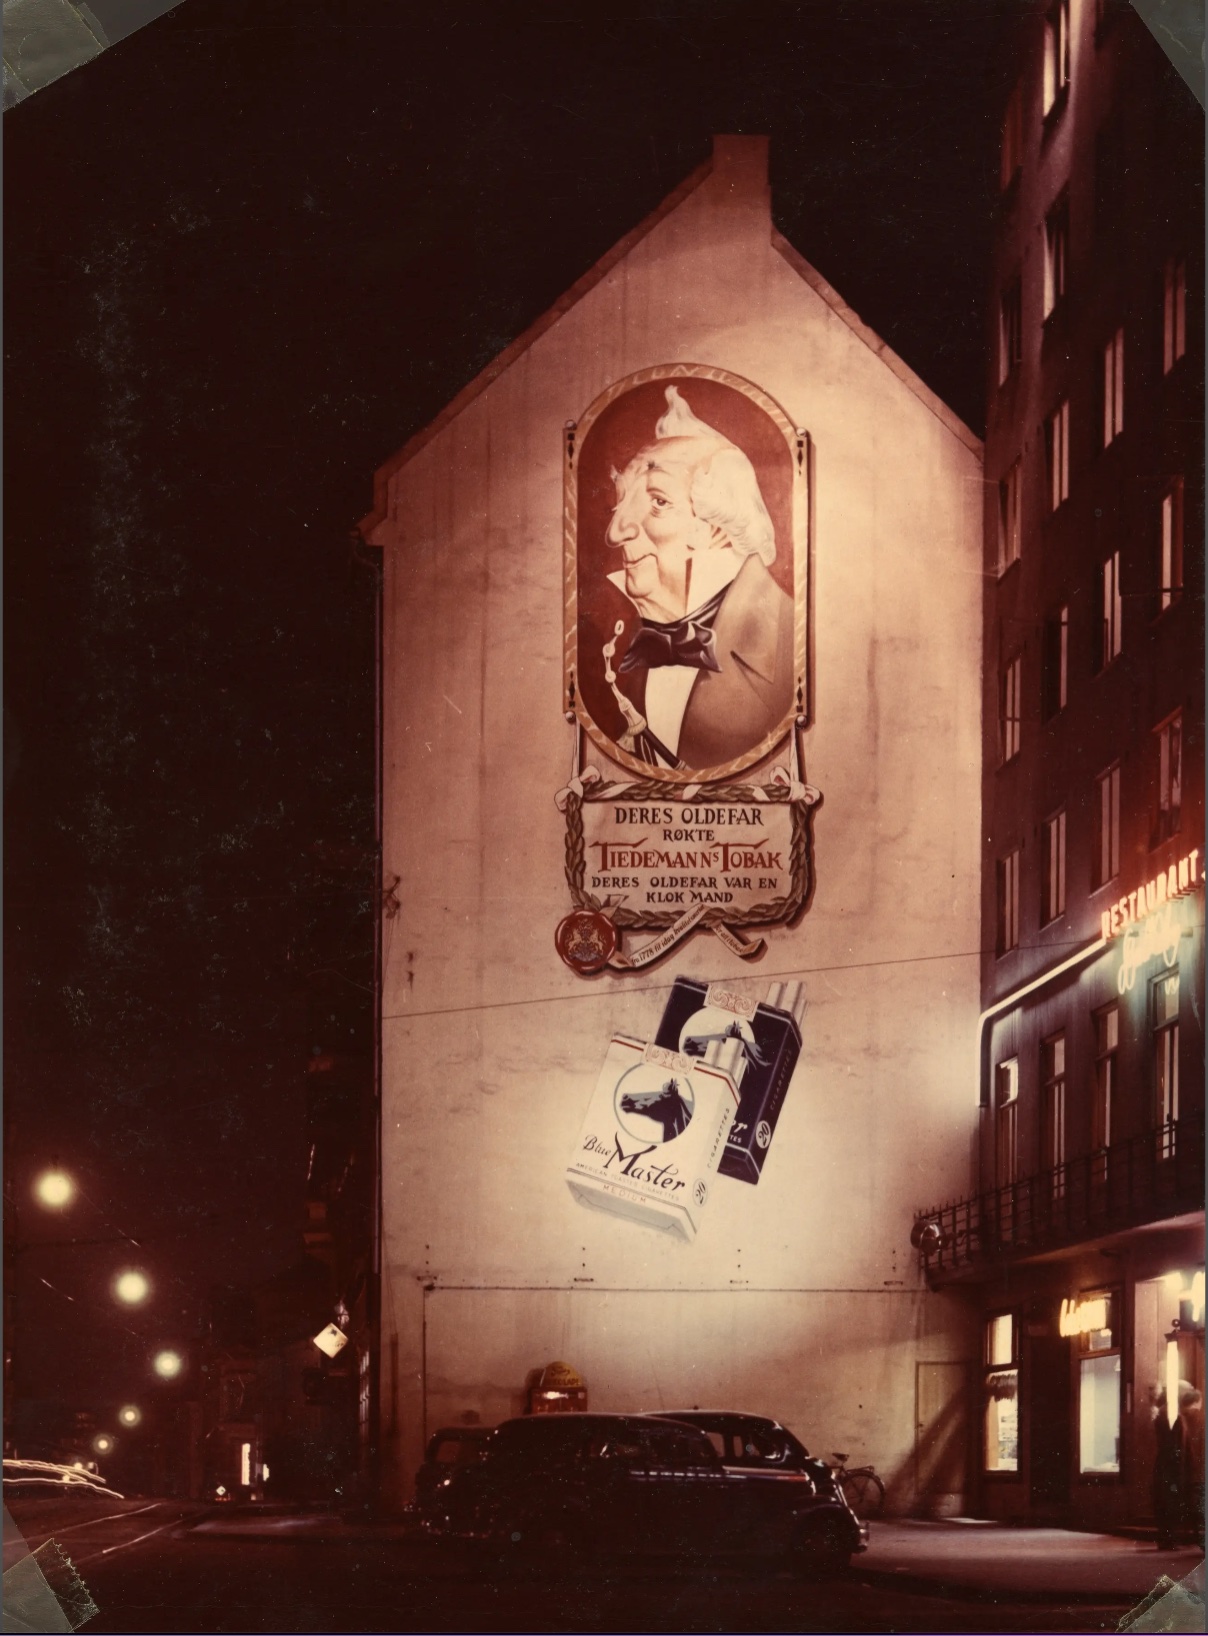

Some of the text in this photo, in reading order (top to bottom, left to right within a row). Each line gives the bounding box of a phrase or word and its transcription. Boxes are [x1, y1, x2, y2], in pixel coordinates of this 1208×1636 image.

[614, 807, 764, 826] DERES OLDEFAR
[663, 829, 715, 842] RØKTE
[710, 838, 783, 873] TOBAK
[591, 876, 777, 889] DERES OLDEFAR VAR EN
[1101, 848, 1199, 939] RESTAURANT
[646, 891, 733, 903] KLOK MAND
[707, 1108, 730, 1169] CIGARETTES
[757, 1122, 770, 1147] 20
[575, 1162, 608, 1177] AMERICAN
[582, 1131, 686, 1191] Blue Master
[603, 1184, 647, 1204] MEDIUM
[695, 1181, 706, 1205] 20
